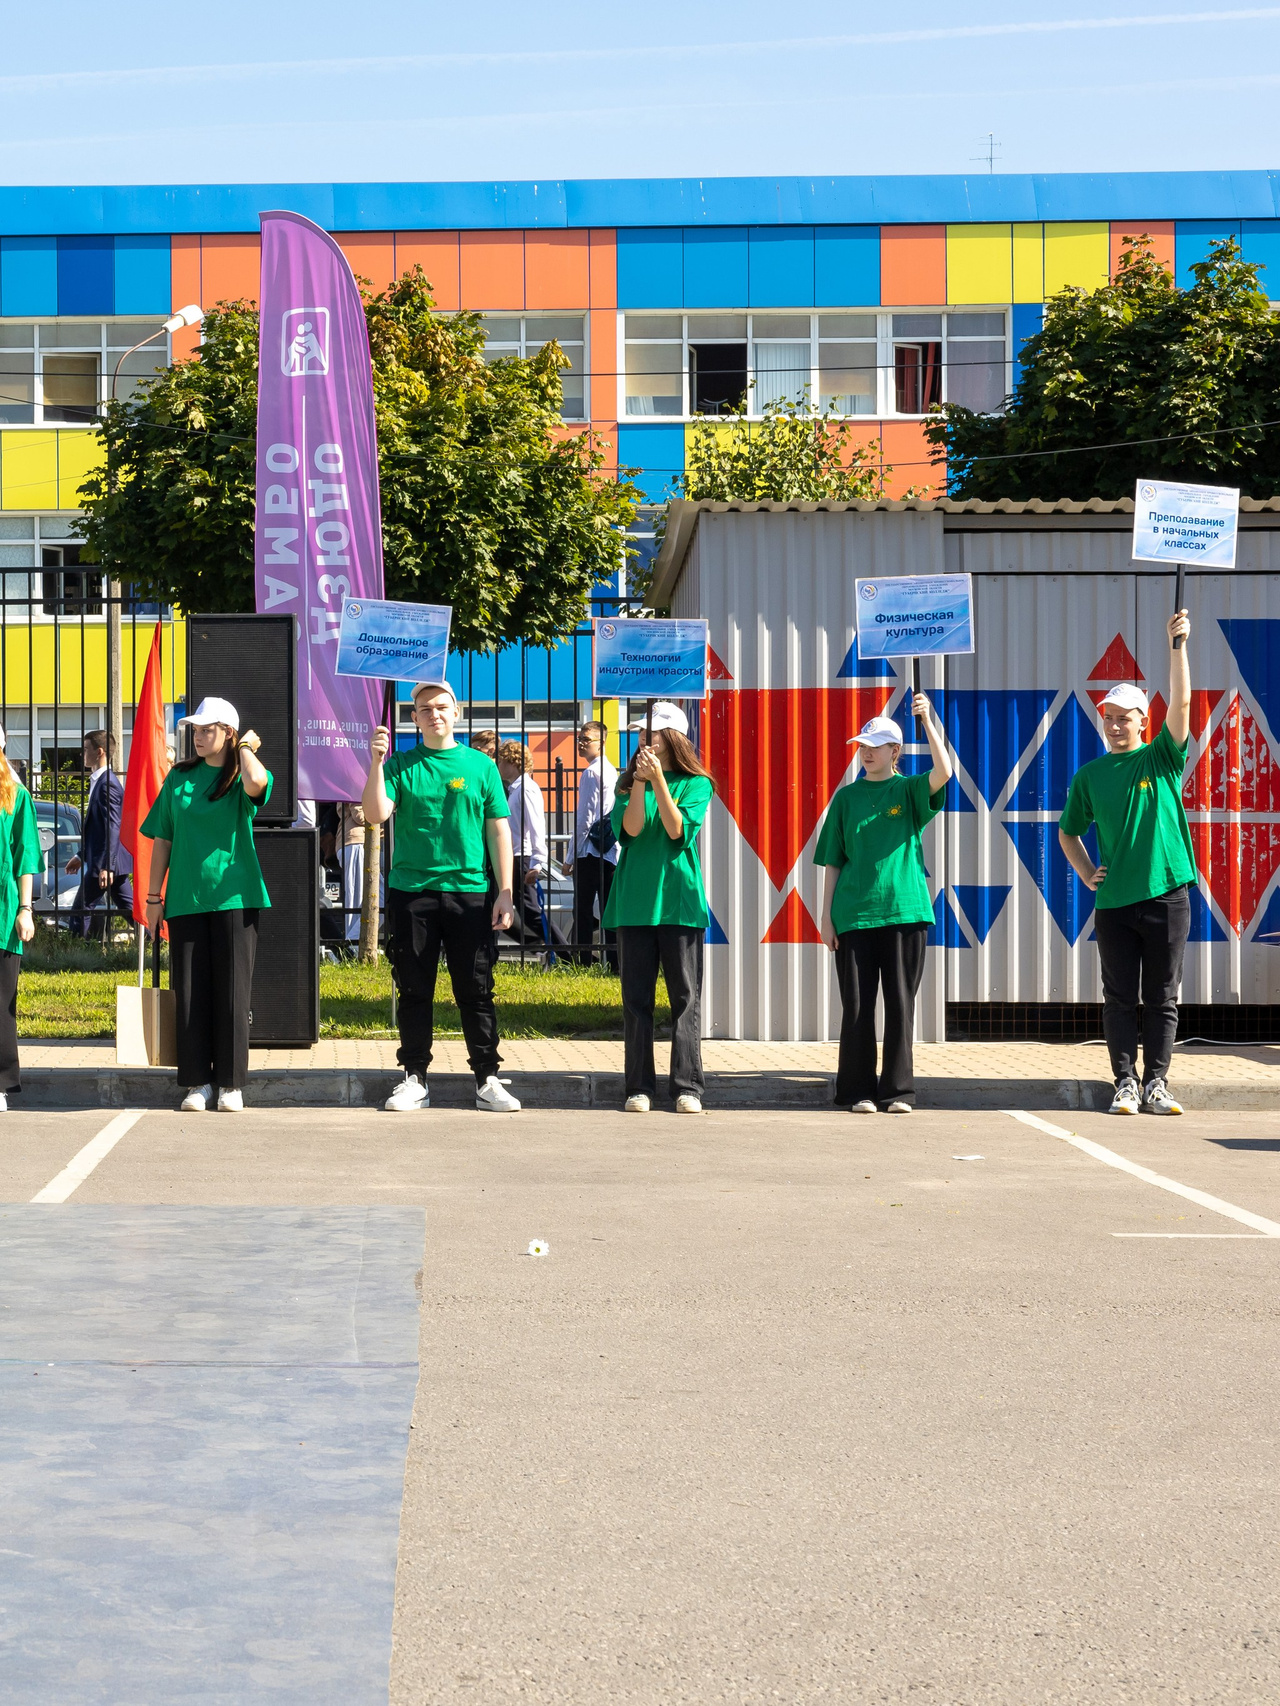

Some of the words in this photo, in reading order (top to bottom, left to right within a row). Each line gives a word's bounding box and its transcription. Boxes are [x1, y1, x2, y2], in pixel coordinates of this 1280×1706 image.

[1149, 511, 1225, 527] Преподавание
[1162, 526, 1219, 539] начальных
[1164, 540, 1206, 550] классах
[875, 612, 954, 624] Физическая
[886, 626, 944, 638] культура
[358, 632, 429, 648] Дошкольное
[356, 646, 429, 660] образование
[620, 652, 681, 662] Технологии
[599, 666, 655, 676] индустрии
[658, 667, 702, 676] красоты
